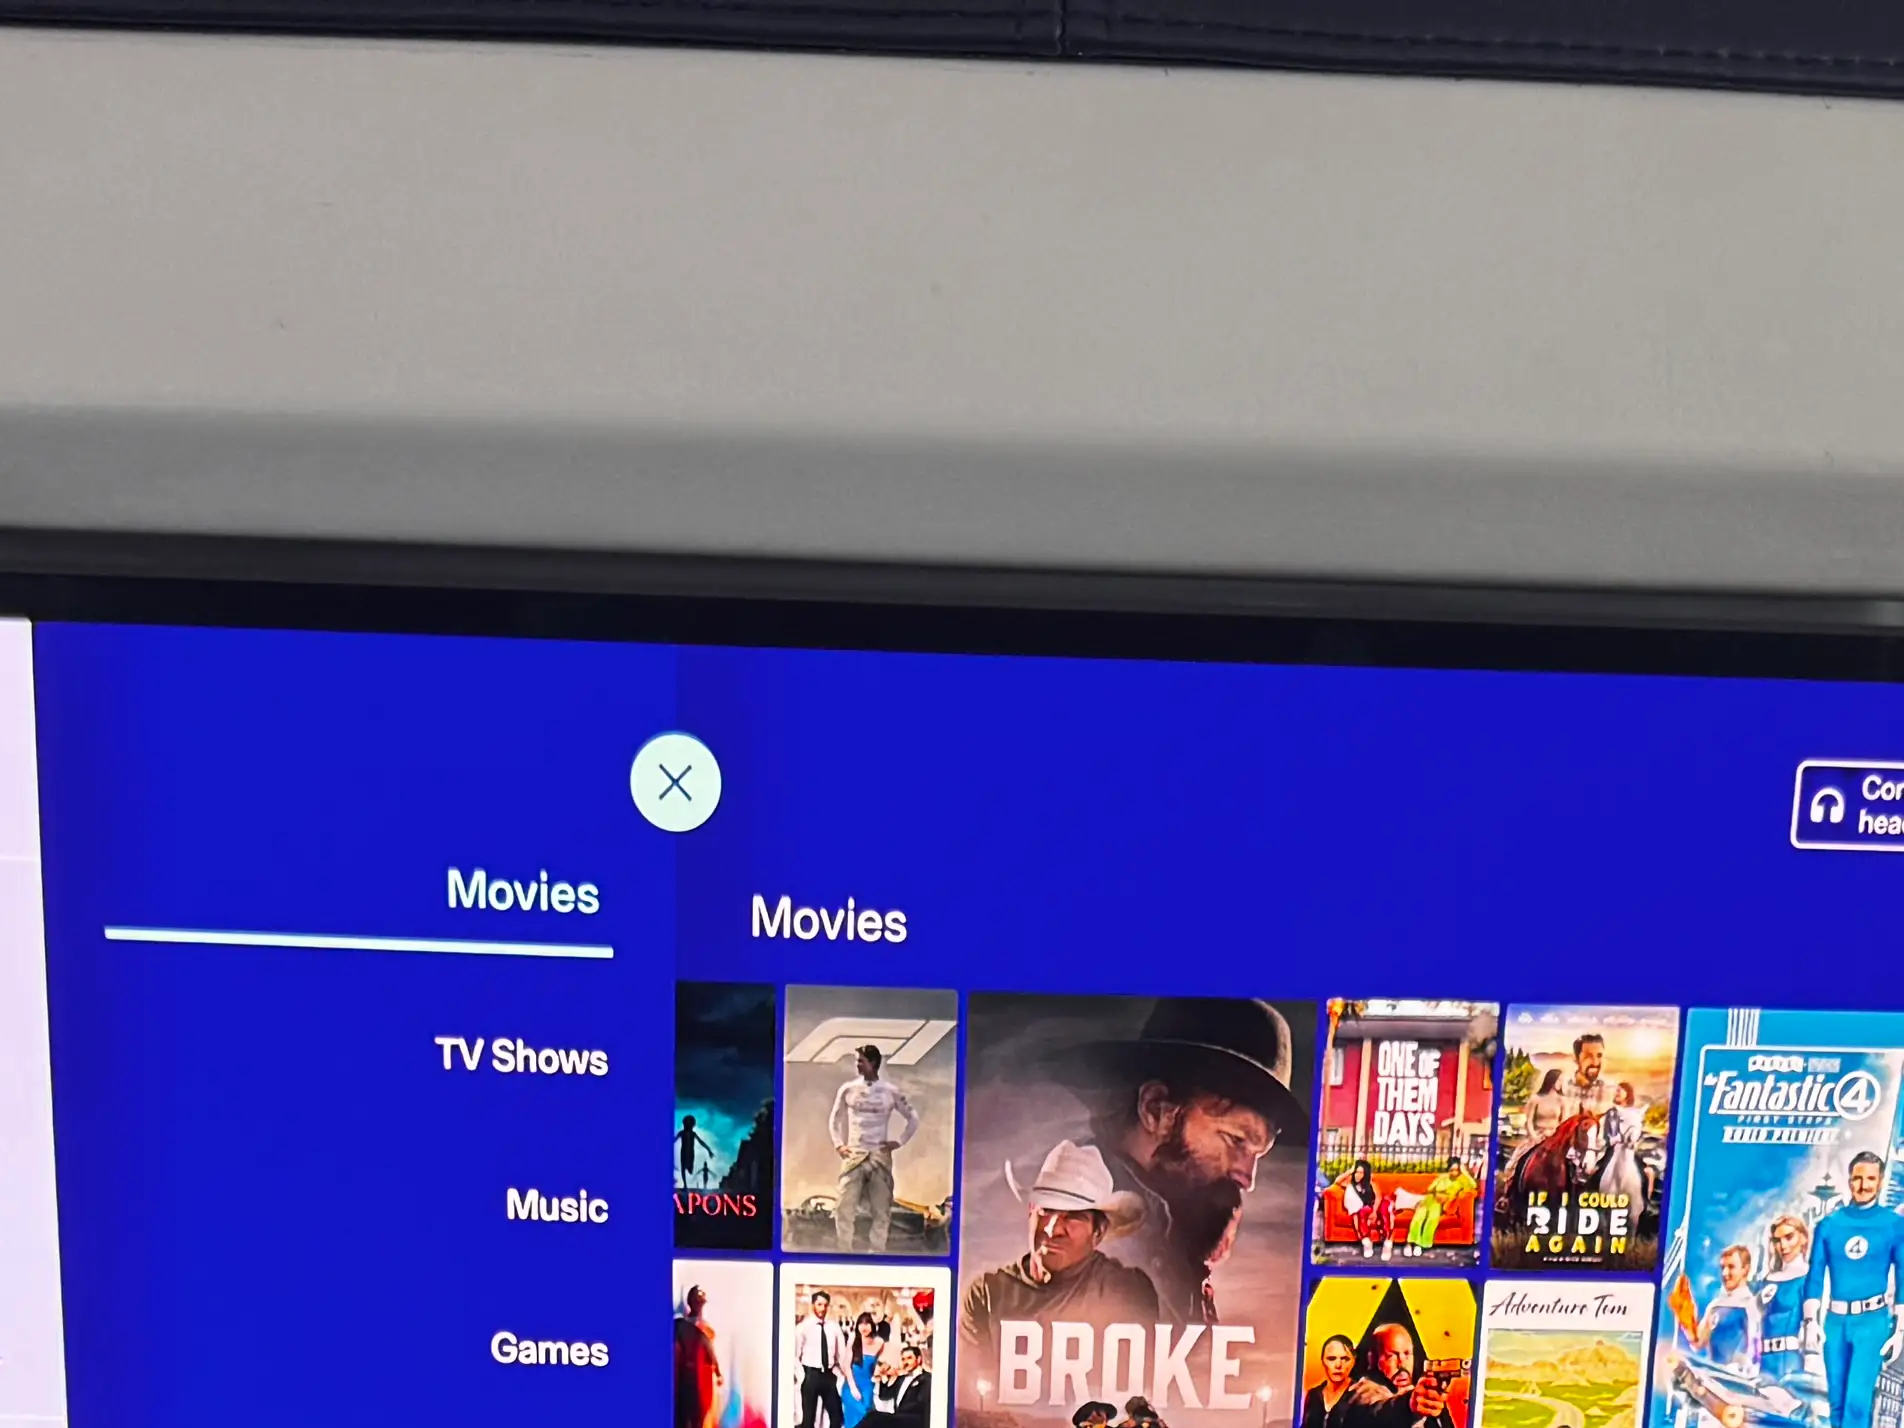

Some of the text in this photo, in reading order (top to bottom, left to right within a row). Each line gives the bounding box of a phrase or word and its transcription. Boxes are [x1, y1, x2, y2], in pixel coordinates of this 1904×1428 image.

[448, 868, 599, 913] Movies
[752, 895, 907, 942] Movies
[435, 1037, 608, 1075] TV Shows
[1378, 1040, 1441, 1078] ONE OF
[1377, 1077, 1438, 1112] THEM
[1708, 1070, 1837, 1115] Fantastic
[1373, 1110, 1436, 1146] DAYS
[507, 1188, 608, 1223] Music
[1528, 1191, 1548, 1206] IF
[1578, 1192, 1629, 1208] COULD
[1526, 1207, 1628, 1235] RIDE
[1525, 1235, 1627, 1254] AGAIN
[1489, 1291, 1588, 1317] Adventure
[491, 1331, 609, 1366] Games
[998, 1319, 1256, 1410] BROKE
